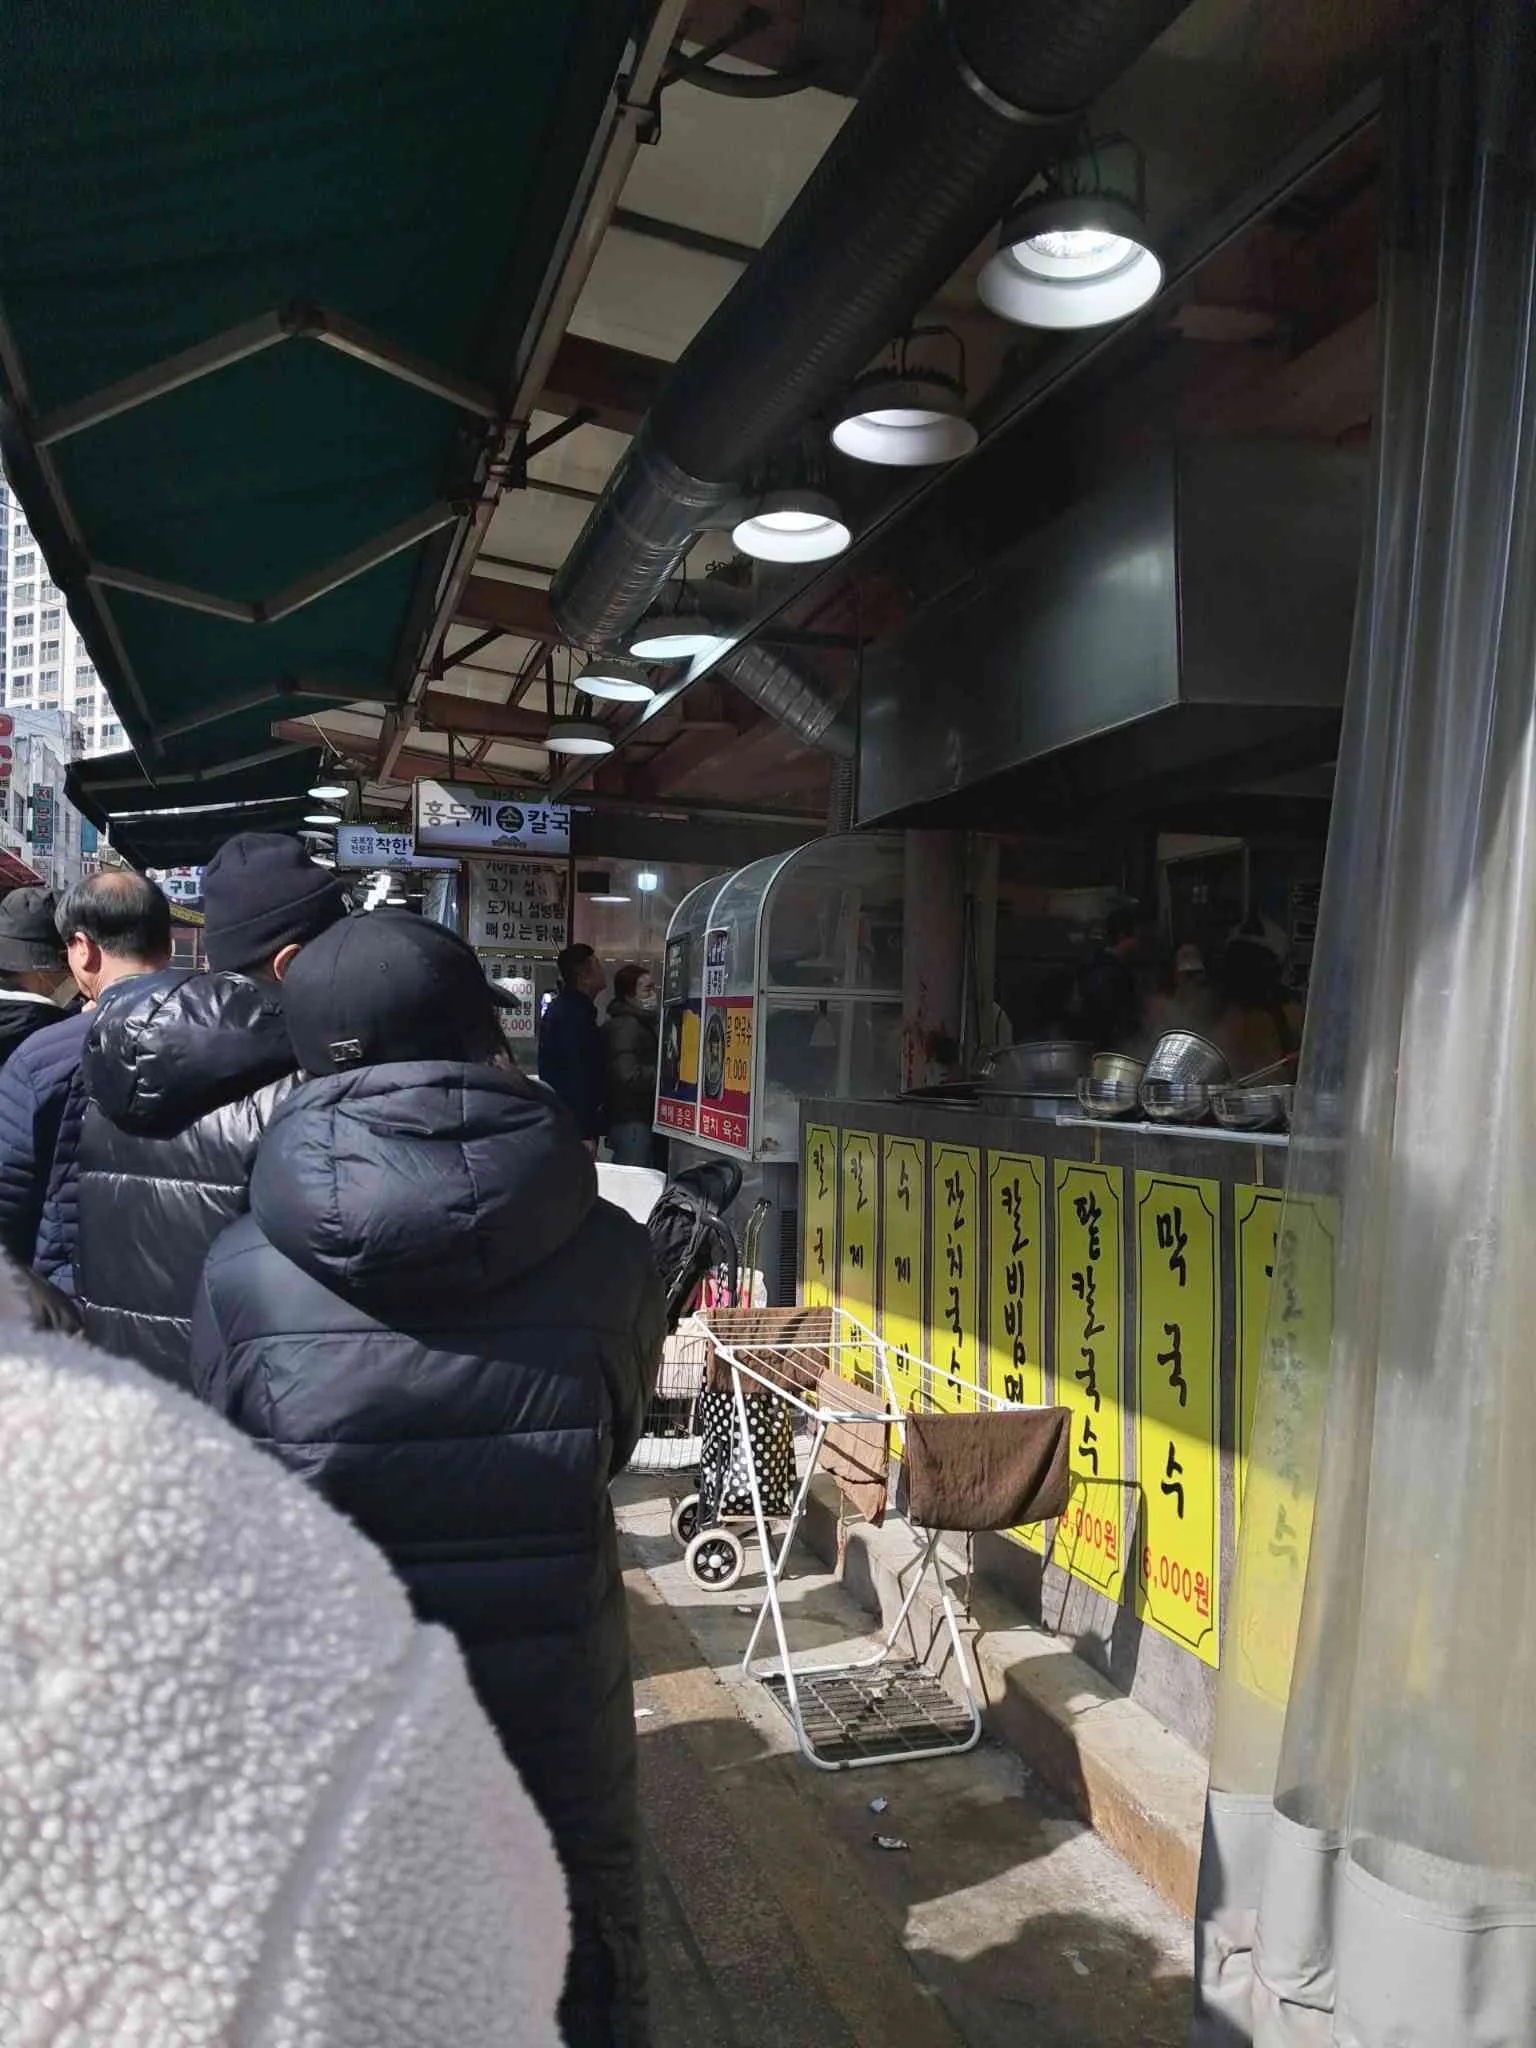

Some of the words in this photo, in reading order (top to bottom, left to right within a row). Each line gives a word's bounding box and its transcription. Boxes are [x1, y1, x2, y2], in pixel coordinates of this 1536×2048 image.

[811, 1143, 829, 1306] 칼국
[894, 1159, 912, 1376] 수제비
[944, 1169, 965, 1405] 잔치국수
[1070, 1191, 1105, 1476] 팥칼국수
[1156, 1206, 1189, 1520] 막국수
